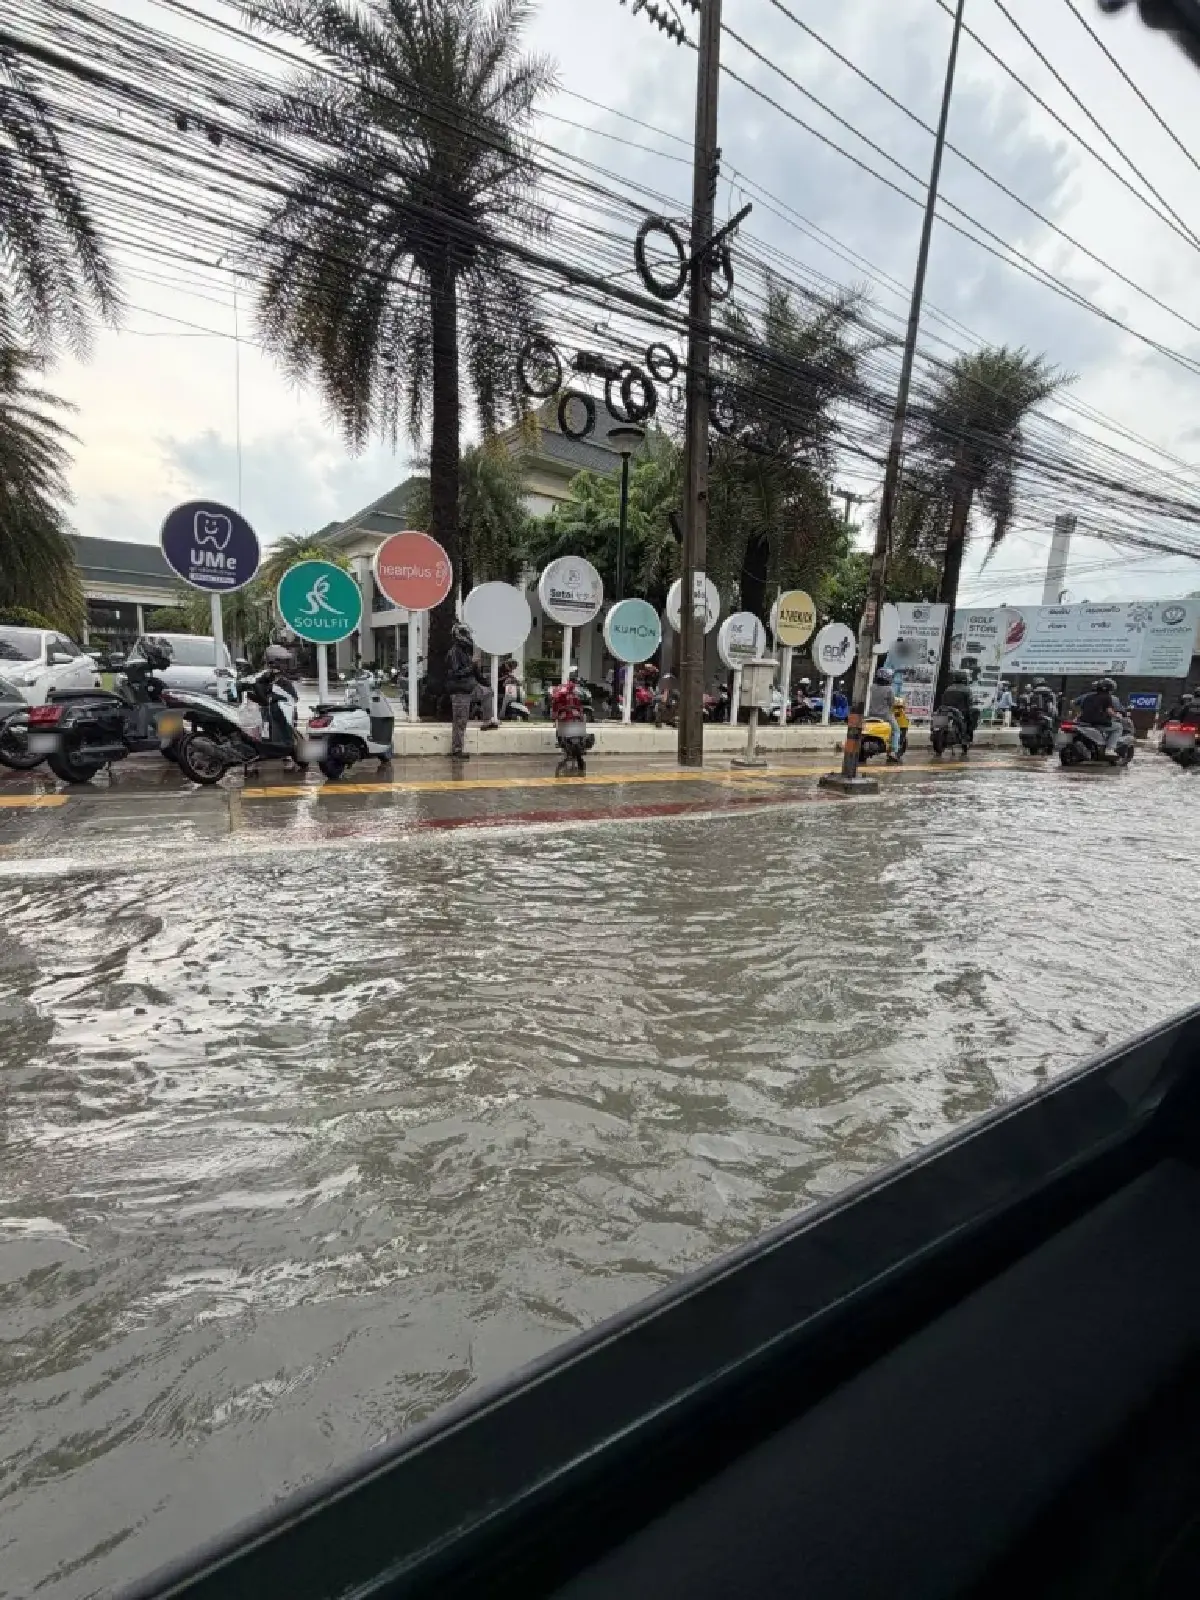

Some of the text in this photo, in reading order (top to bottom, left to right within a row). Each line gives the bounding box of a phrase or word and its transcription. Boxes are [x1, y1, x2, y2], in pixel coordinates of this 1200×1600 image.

[190, 548, 237, 570] UMe
[379, 562, 432, 580] hearplus
[294, 616, 349, 629] SOULFIT
[614, 624, 656, 638] KUMON
